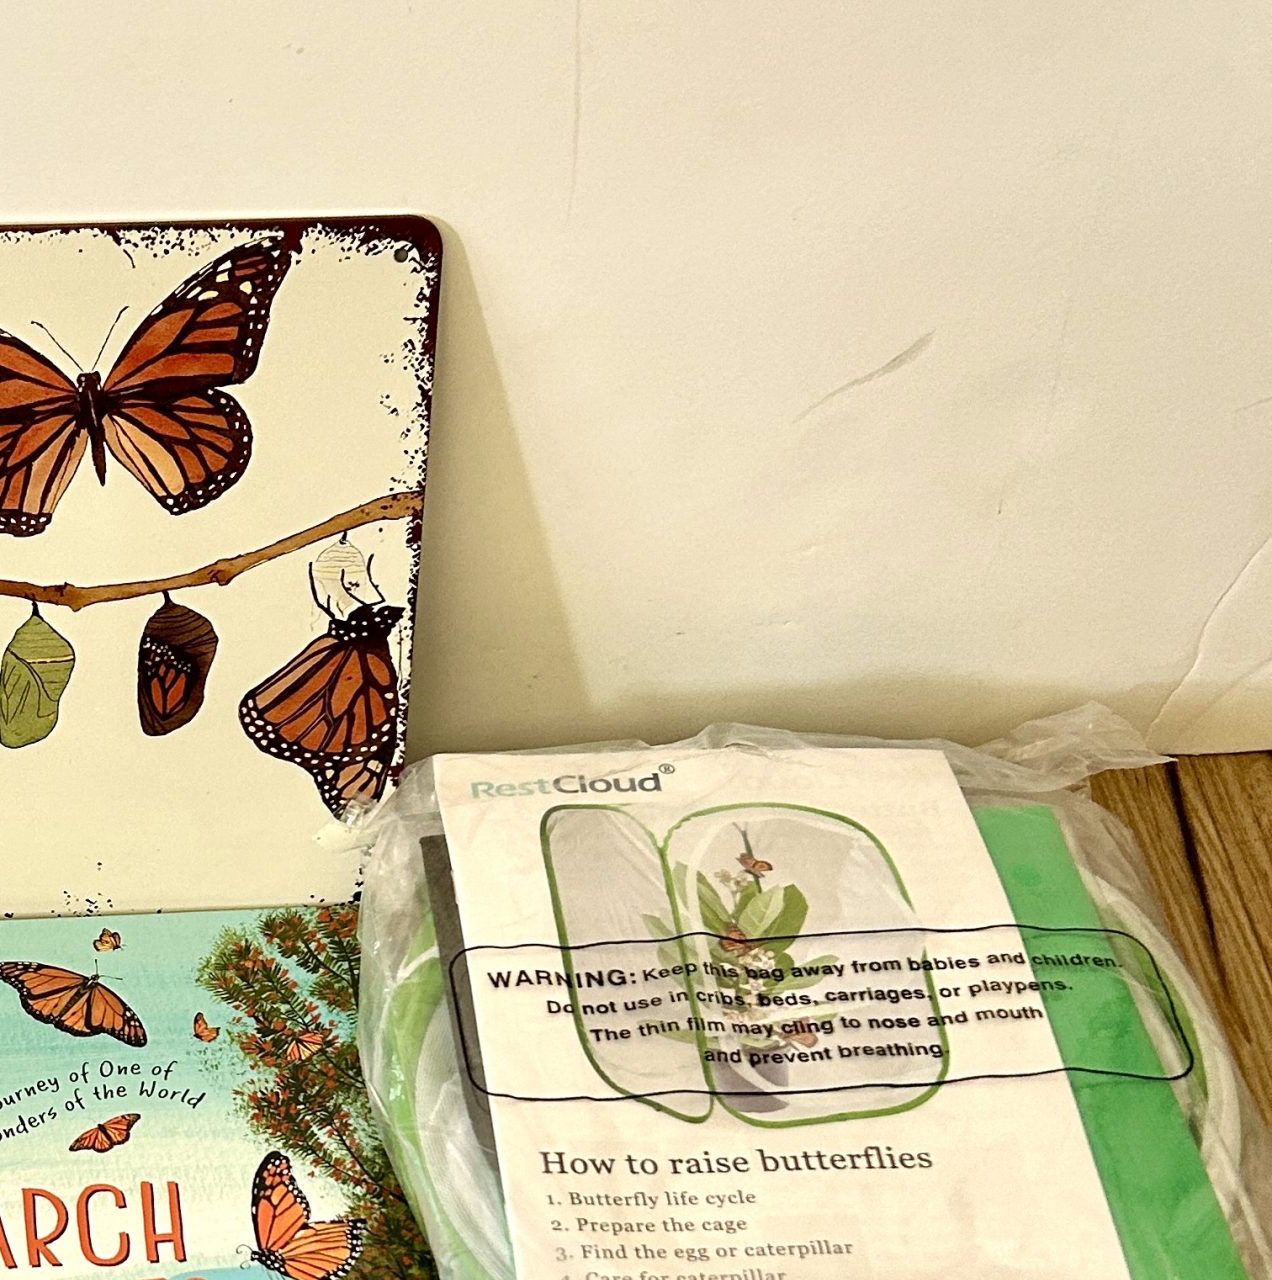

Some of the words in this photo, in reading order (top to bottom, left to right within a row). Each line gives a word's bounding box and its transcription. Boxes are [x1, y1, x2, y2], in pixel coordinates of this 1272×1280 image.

[487, 970, 637, 989] WARNING:
[643, 962, 698, 981] Keep
[703, 962, 738, 979] this
[745, 963, 785, 982] bag
[790, 963, 844, 983] away
[851, 958, 902, 973] from
[908, 954, 980, 972] babies
[987, 951, 1025, 966] and
[1031, 953, 1123, 969] children.
[547, 999, 576, 1015] Do
[583, 1000, 617, 1015] not
[624, 996, 663, 1011] use
[669, 989, 689, 1004] in
[696, 989, 752, 1009] cribs,
[758, 992, 817, 1009] beds,
[825, 984, 933, 1006] carriages,
[939, 984, 961, 998] or
[968, 978, 1073, 998] playpens.
[590, 1025, 631, 1043] The
[637, 1019, 681, 1036] thin
[686, 1017, 726, 1034] film
[732, 1019, 774, 1038] may
[781, 1018, 834, 1035] cling
[840, 1015, 861, 1030] to
[868, 1015, 921, 1030] nose
[928, 1011, 968, 1026] and
[976, 1006, 1044, 1021] mouth
[704, 1047, 742, 1064] and
[749, 1046, 832, 1068] prevent
[68, 1060, 91, 1086] of
[99, 1060, 143, 1079] One
[151, 1060, 179, 1079] of
[64, 1087, 84, 1112] of
[93, 1080, 128, 1099] the
[138, 1080, 208, 1110] World
[540, 1151, 617, 1176] How
[625, 1153, 659, 1174] to
[669, 1151, 750, 1175] raise
[755, 1145, 934, 1173] butterflies
[546, 1194, 562, 1207] 1.
[568, 1190, 659, 1209] Butterfly
[665, 1189, 699, 1206] life
[705, 1189, 757, 1208] cycle
[551, 1219, 569, 1232] 2.
[576, 1217, 656, 1236] Prepare
[662, 1217, 696, 1233] the
[701, 1217, 748, 1235] cage
[556, 1247, 574, 1262] 3.
[581, 1243, 628, 1260] Find
[634, 1243, 668, 1259] the
[674, 1244, 710, 1263] egg
[716, 1243, 738, 1258] or
[744, 1240, 853, 1260] caterpillar
